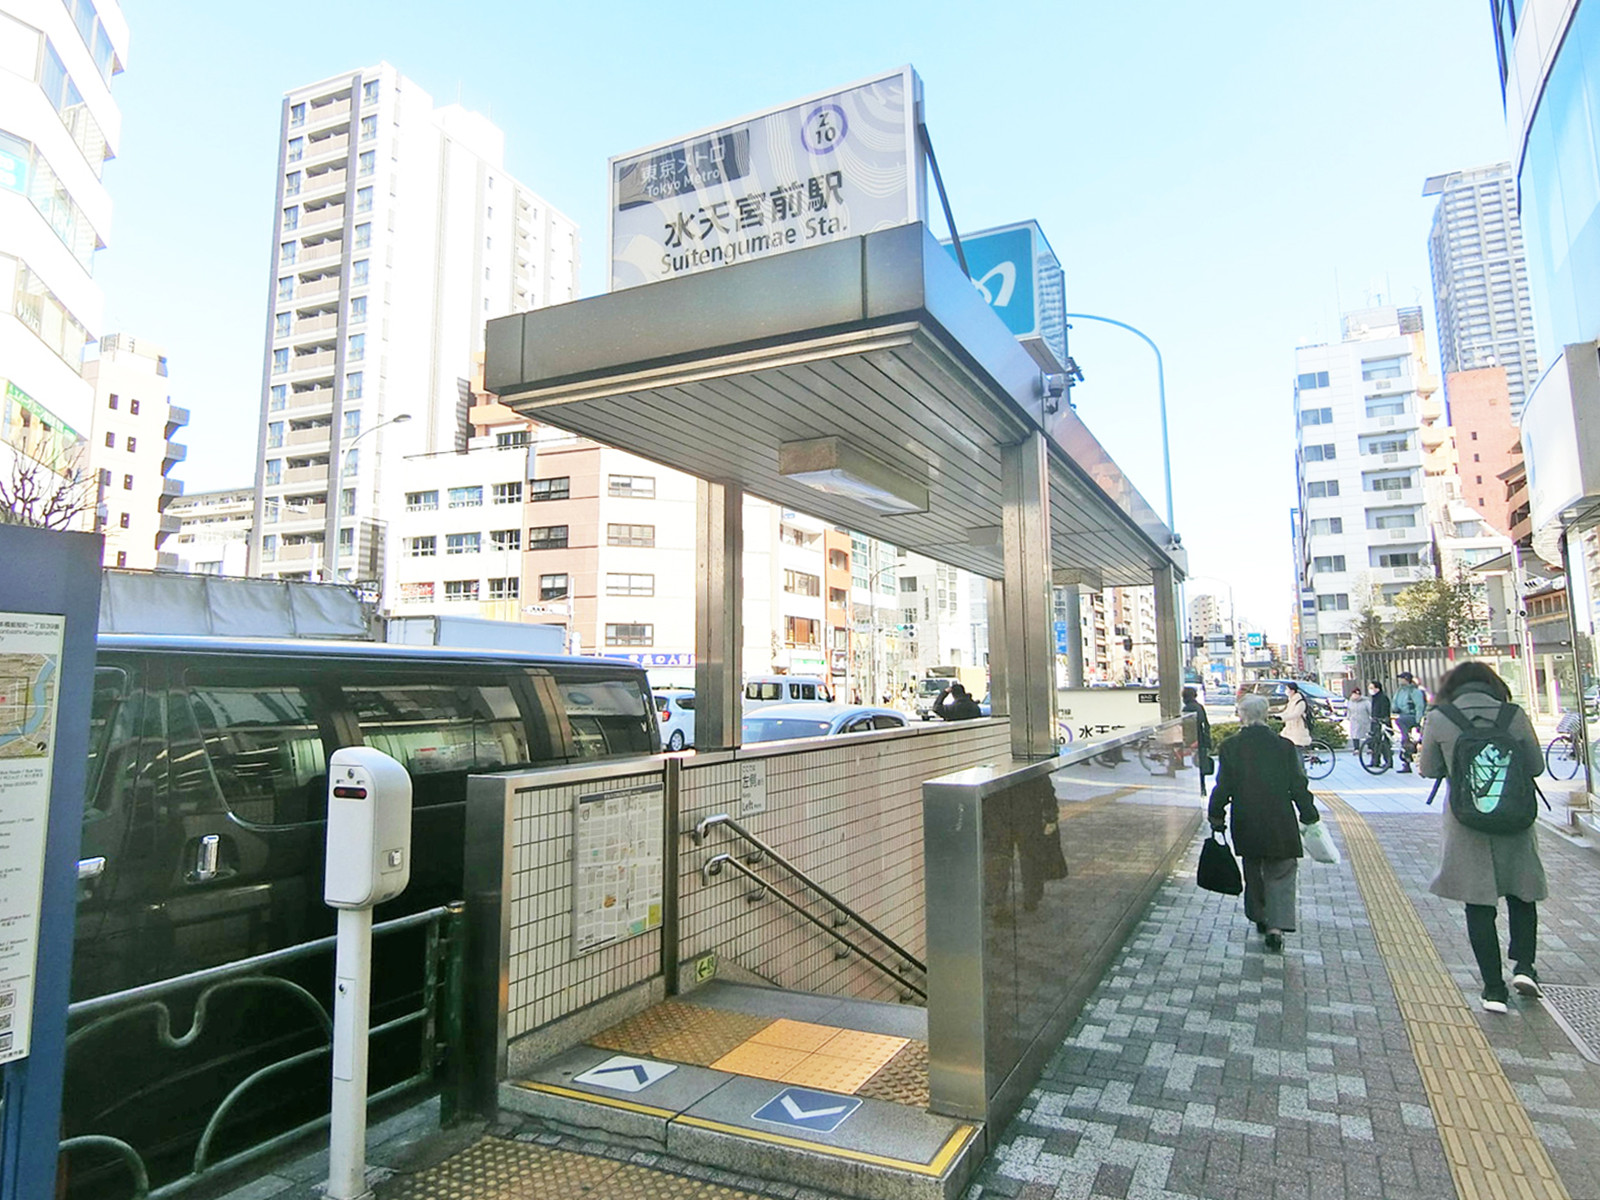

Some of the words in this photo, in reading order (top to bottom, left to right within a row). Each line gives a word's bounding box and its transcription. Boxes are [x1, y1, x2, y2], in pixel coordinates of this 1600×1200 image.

[815, 127, 836, 144] 10
[818, 112, 829, 127] Z
[641, 143, 725, 184] 東京メトロ
[647, 181, 680, 197] Tokyo
[684, 168, 719, 188] Metro
[664, 171, 844, 248] 水天宮前駅
[661, 227, 797, 274] Suitengumae
[806, 215, 847, 239] Sta.
